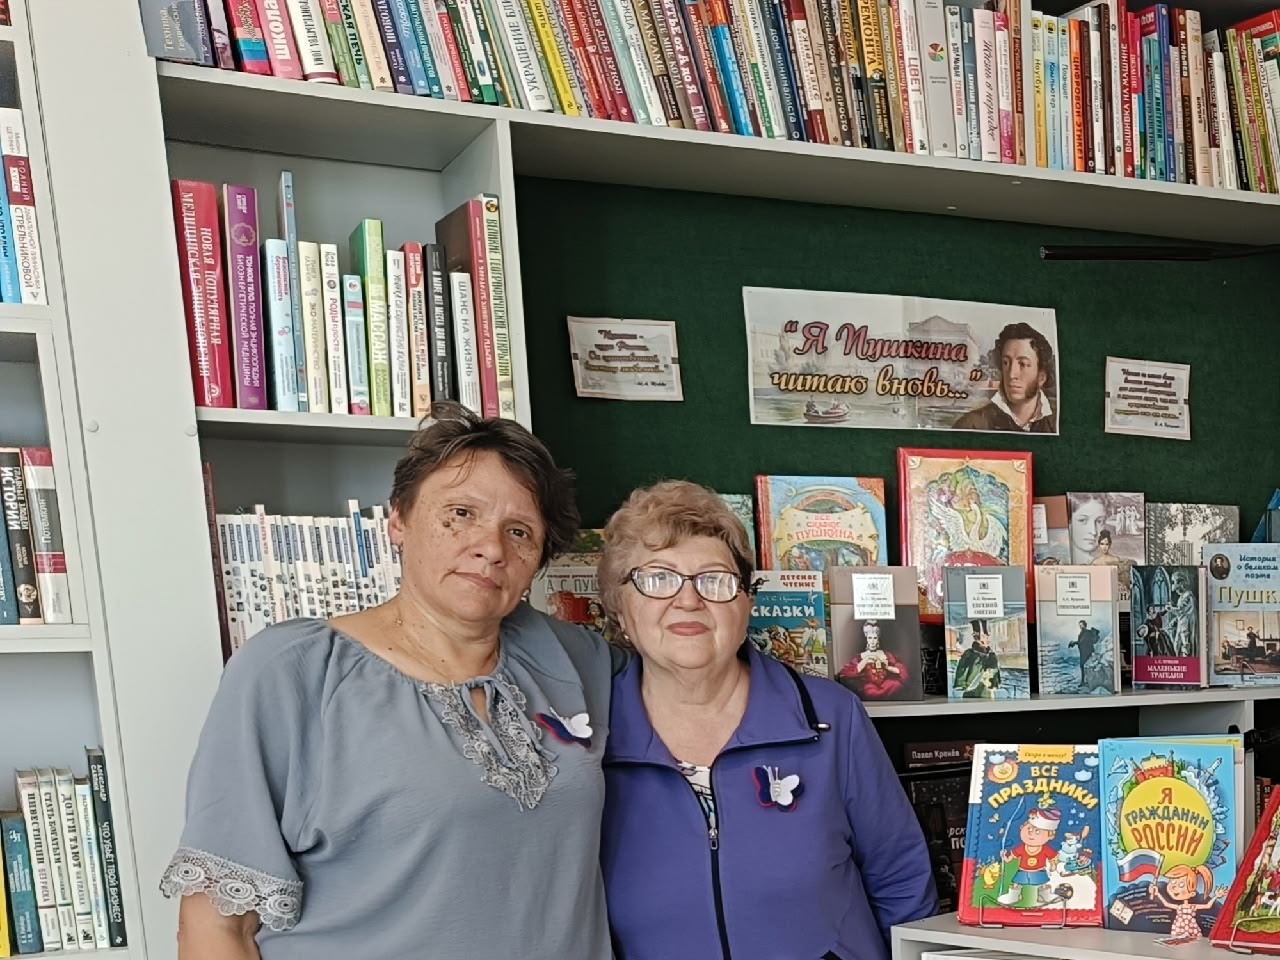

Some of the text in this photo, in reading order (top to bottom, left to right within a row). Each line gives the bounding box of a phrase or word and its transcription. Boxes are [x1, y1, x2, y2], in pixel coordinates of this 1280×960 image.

[640, 8, 664, 72] МАКРАМЕ
[769, 27, 782, 50] ДОМ
[508, 20, 541, 93] УКРАШЕНИЕ
[603, 56, 624, 95] КУКОЛ
[908, 56, 922, 95] ЦВЕТ
[1072, 55, 1082, 117] ЦИФРОВОЙ
[1121, 102, 1133, 153] ВЫШИВКА
[19, 159, 30, 201] ПОЛНЫЙ
[14, 206, 34, 287] СТРЕЛЬНИКОВОЙ
[181, 190, 202, 280] МЕДИЦИНСКАЯ
[200, 227, 222, 346] НОВАЯ ПОПУЛЯРНАЯ
[329, 296, 340, 323] РОДЫ
[368, 300, 388, 366] МАССАЖ
[458, 280, 474, 378] ШАНС НА ЖИЗНЬ
[835, 323, 970, 364] Пушкина
[240, 340, 251, 386] МЕДИЦИНЫ
[770, 367, 868, 398] читаю
[1, 466, 20, 531] ИСТОРИИ
[13, 466, 29, 530] ГЛАВНЫЕ ЗЛОДЕИ
[794, 528, 856, 542] ПУШКИНА
[1236, 553, 1278, 564] История
[1243, 561, 1279, 572] великом
[1244, 571, 1271, 580] поэте
[779, 573, 818, 582] ДЕТСКОЕ
[782, 581, 816, 589] ЧТЕНИЕ
[750, 604, 816, 618] СКАЗКИ
[1146, 663, 1188, 674] МАЛЕНЬКИЕ
[1149, 670, 1186, 680] ТРАГЕДИИ
[911, 750, 934, 759] Павел
[1030, 765, 1059, 778] ВСЕ
[987, 777, 1100, 810] ПРАЗДНИКИ
[1160, 787, 1174, 806] Я
[27, 792, 45, 865] ИНВЕСТИЦИИ
[43, 791, 62, 864] СТАТЬ БОГАТЫМ
[61, 792, 79, 834] ДОЛГИ
[100, 821, 112, 837] ЧТО
[1123, 806, 1211, 831] ГРАЖДАНИН
[69, 834, 83, 869] ТАЮТ
[1130, 822, 1205, 857] РОССИИ
[107, 863, 119, 887] ТВОЙ
[109, 887, 123, 923] БИЗНЕС?
